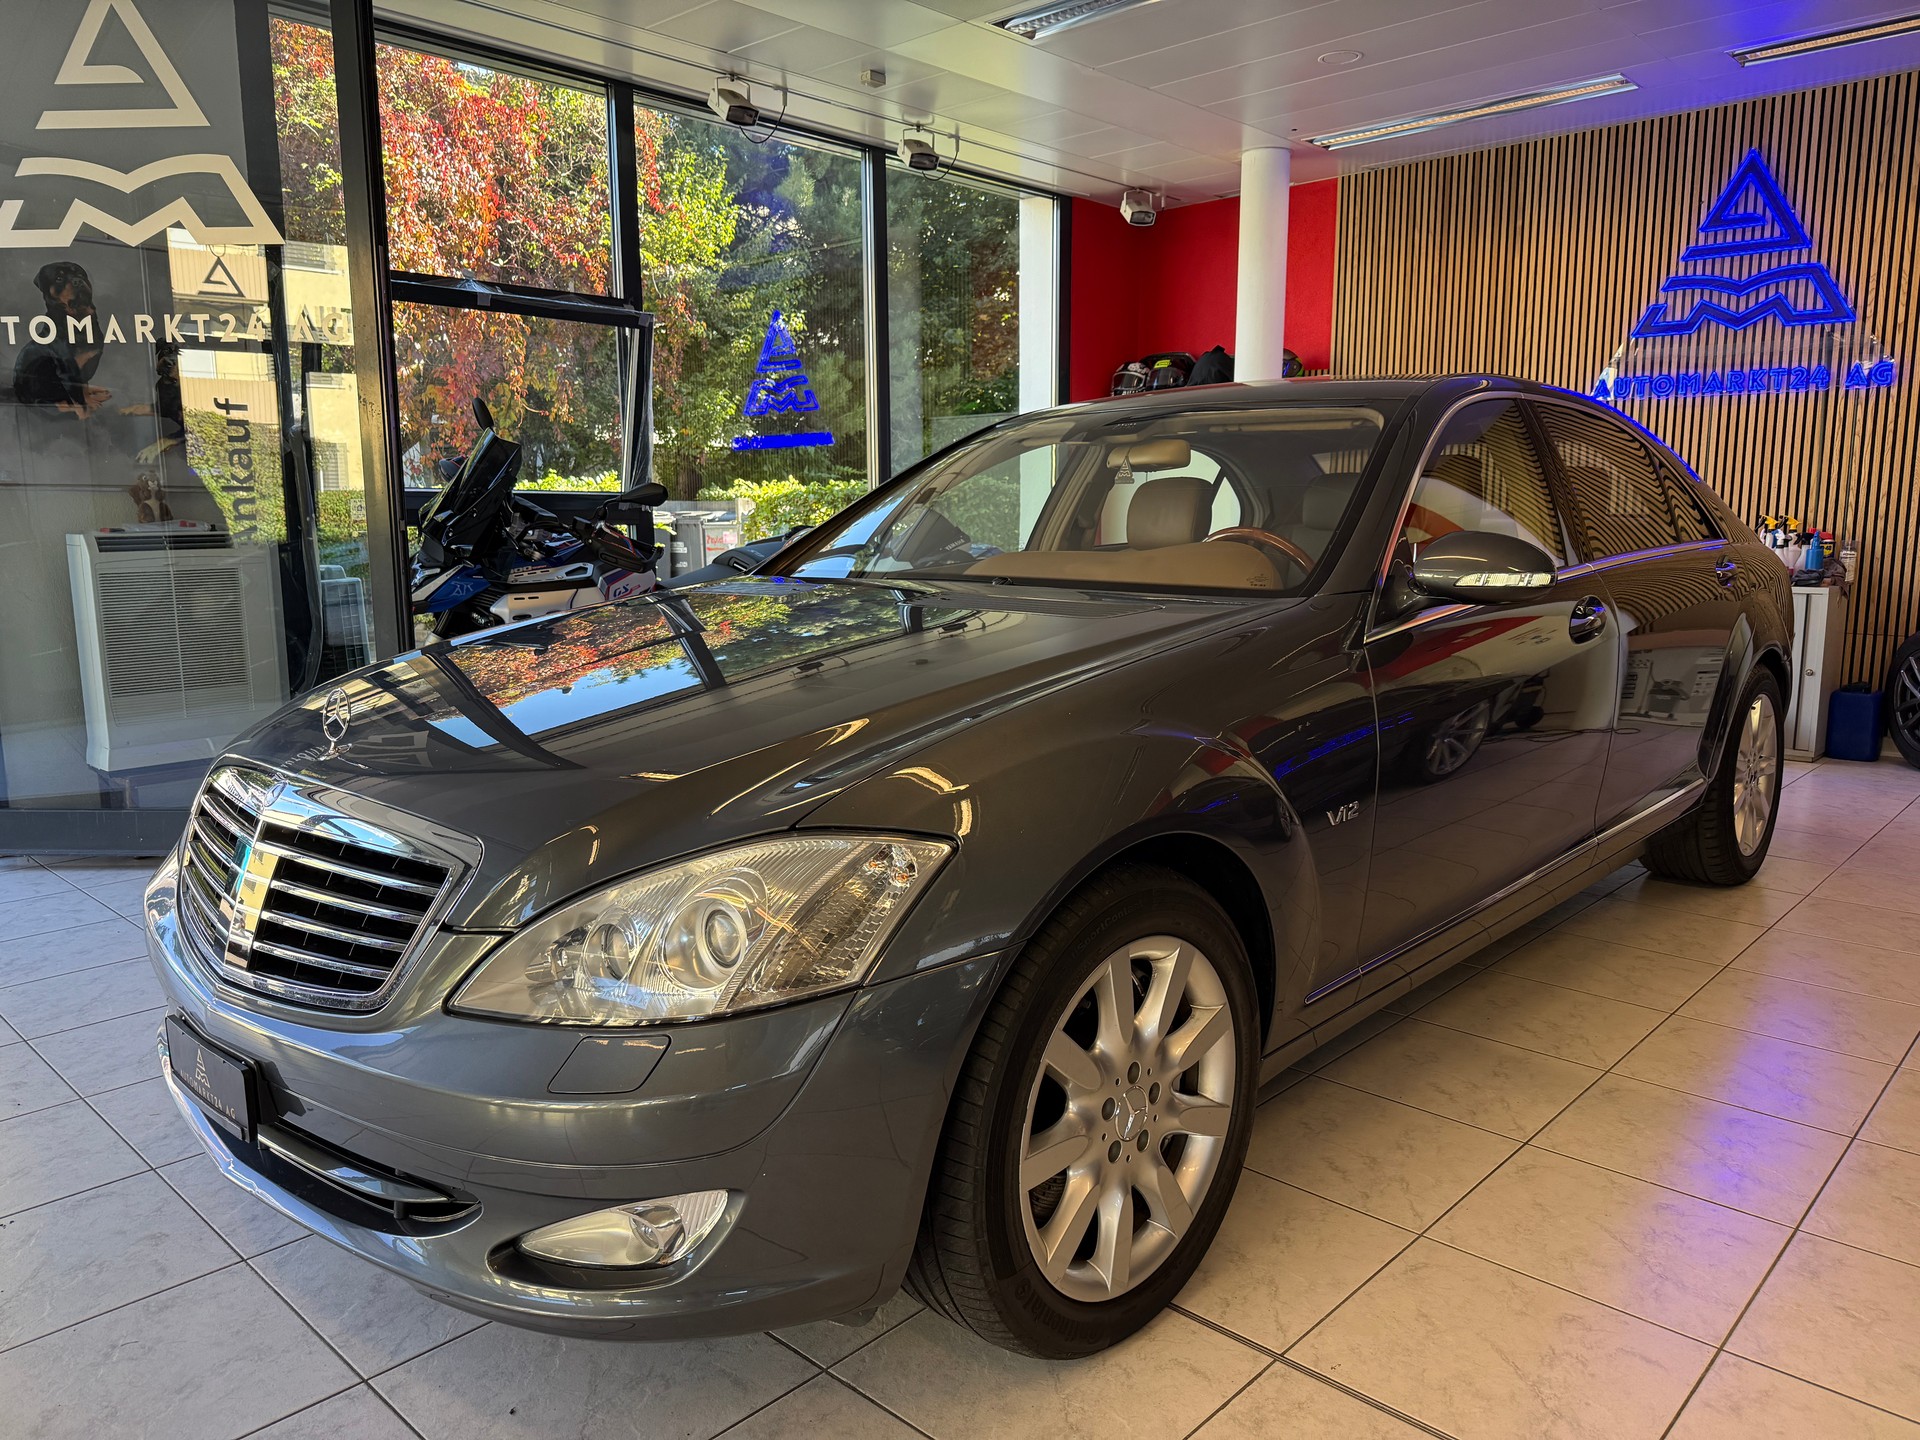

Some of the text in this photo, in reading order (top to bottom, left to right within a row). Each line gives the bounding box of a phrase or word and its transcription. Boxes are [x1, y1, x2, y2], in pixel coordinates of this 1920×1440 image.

[292, 304, 346, 342] AG
[1593, 360, 1895, 399] AUTOMARKT24 AG
[1326, 801, 1360, 826] V12
[180, 1069, 236, 1120] AUTOMARKT24 AG
